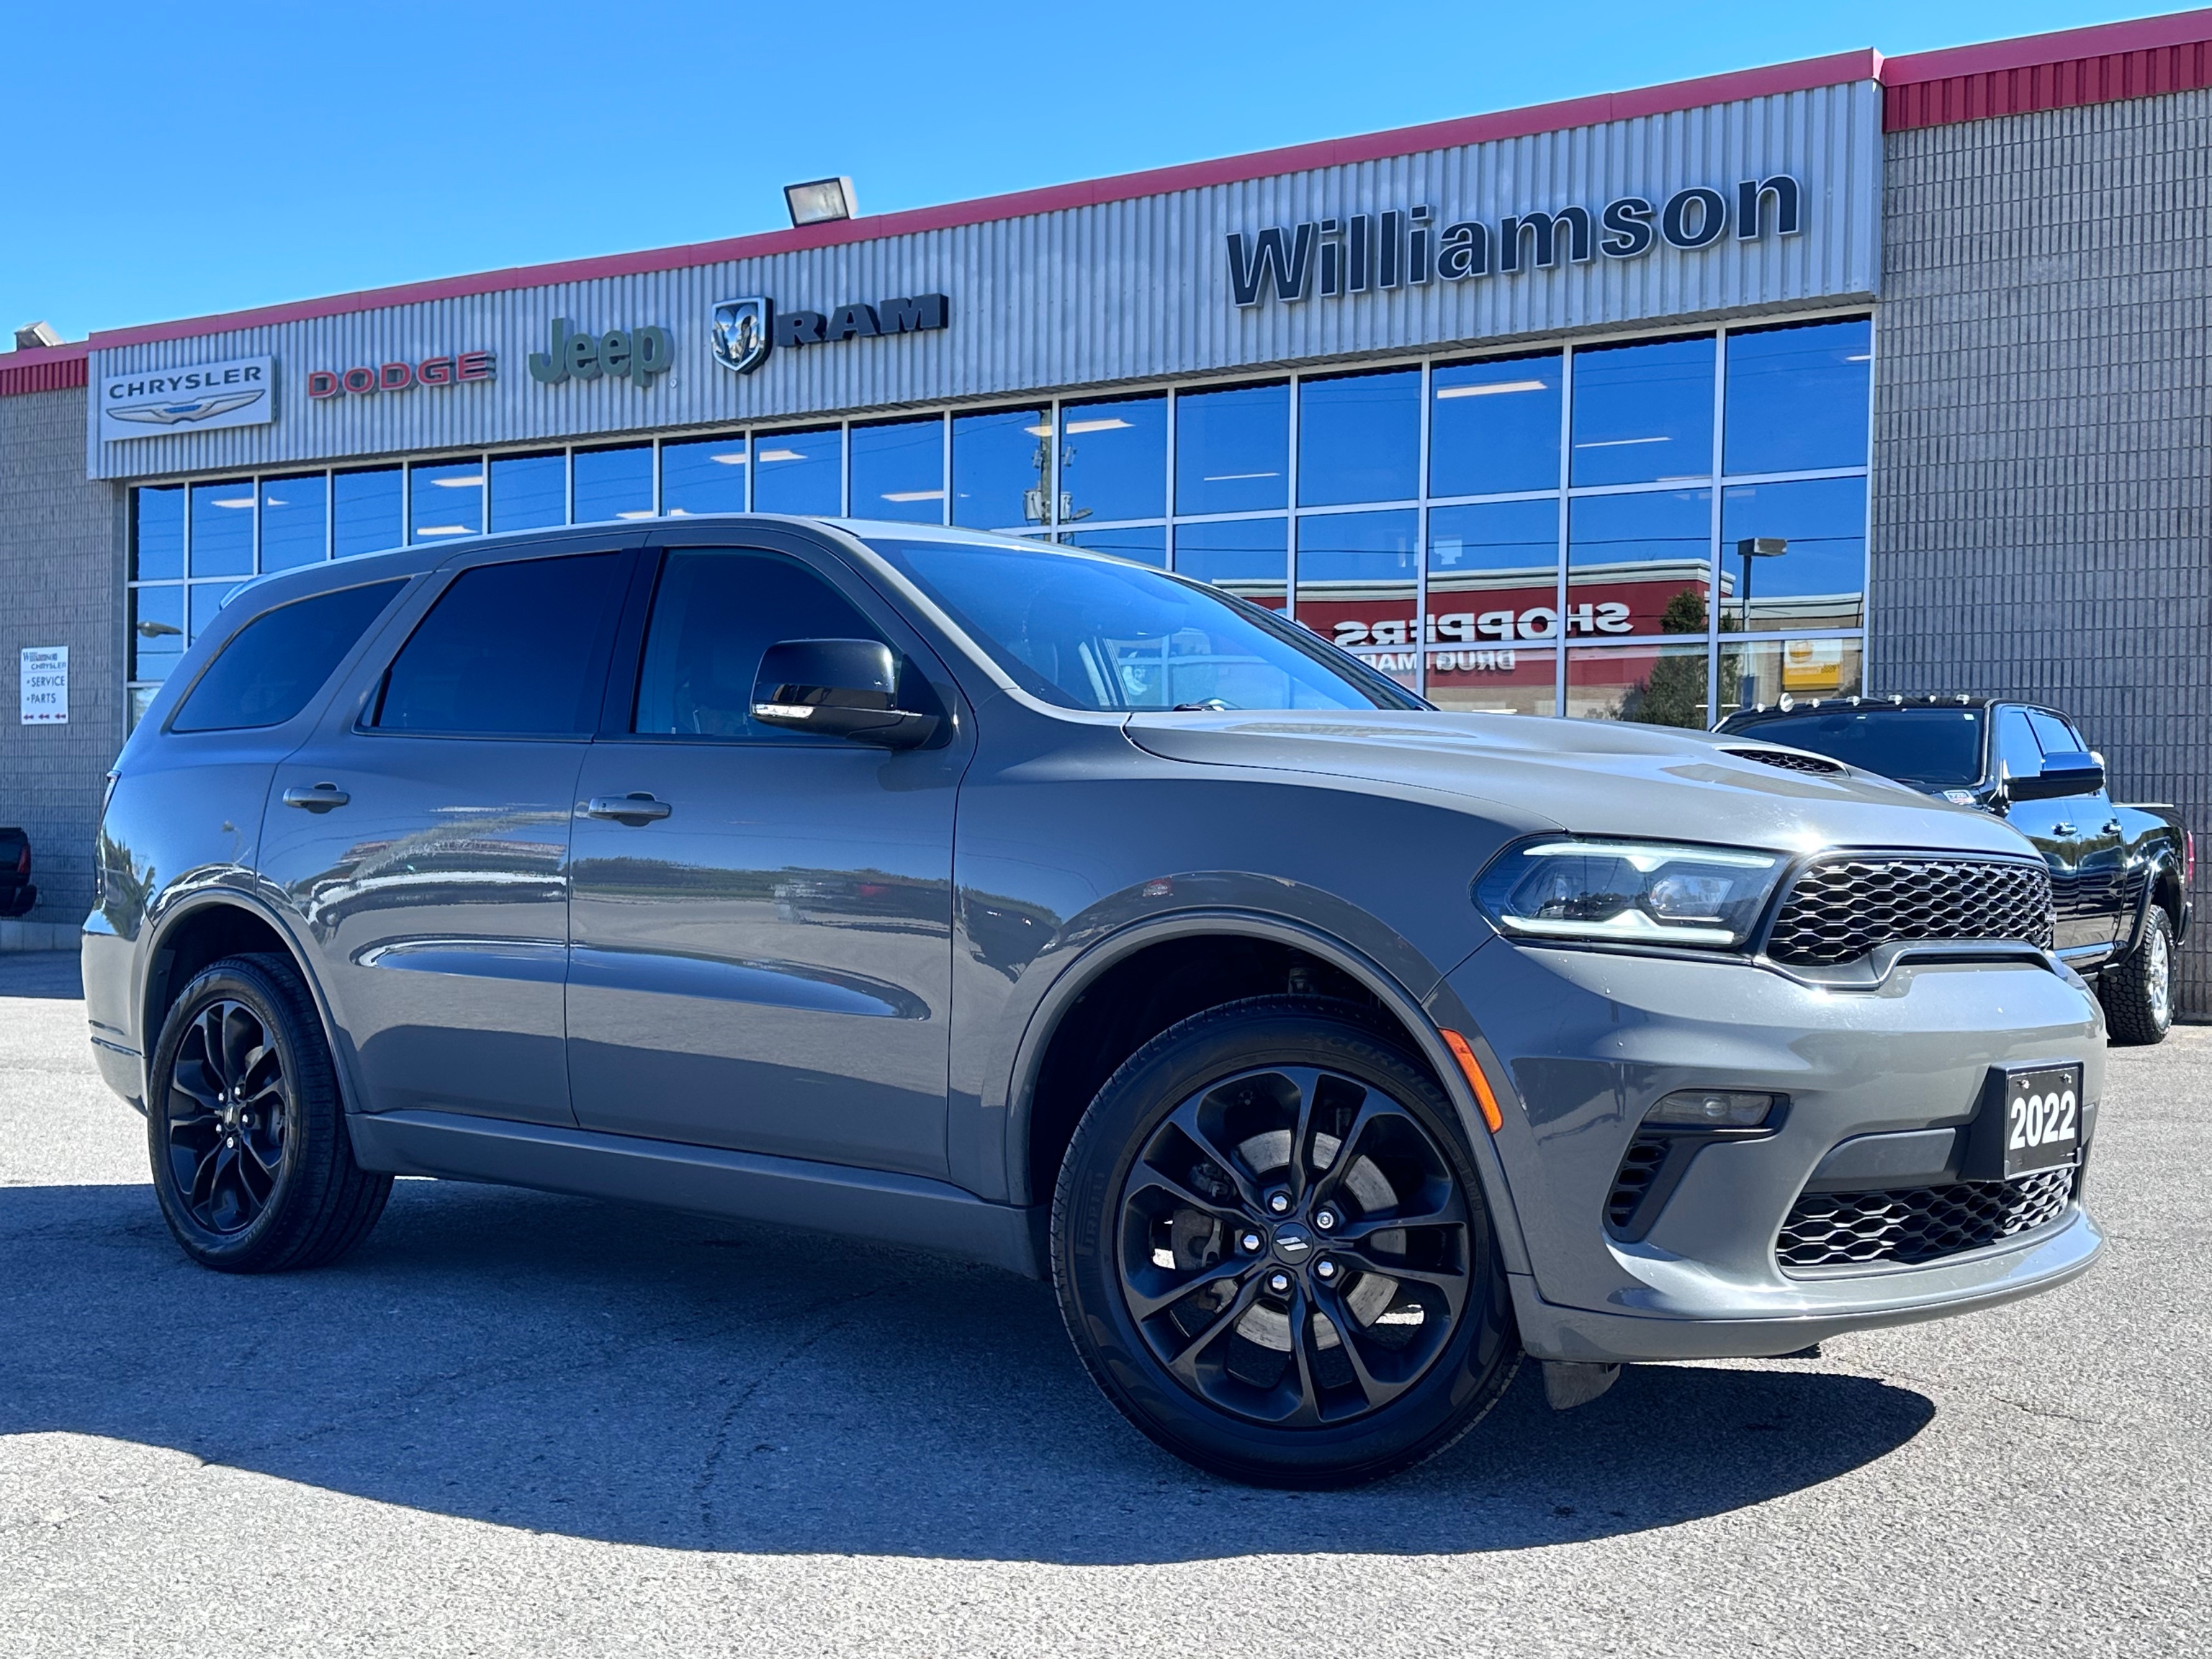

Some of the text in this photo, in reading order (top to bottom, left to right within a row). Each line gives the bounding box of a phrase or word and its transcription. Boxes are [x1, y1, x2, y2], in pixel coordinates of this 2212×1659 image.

[1226, 174, 1804, 308] Williamson
[778, 293, 949, 348] RAM
[307, 351, 495, 400] DODGE
[529, 318, 673, 389] Jeep
[109, 366, 262, 399] CHRYSLER
[31, 675, 65, 687] SERVICE
[31, 693, 56, 704] PARTS
[2009, 1089, 2076, 1151] 2022
